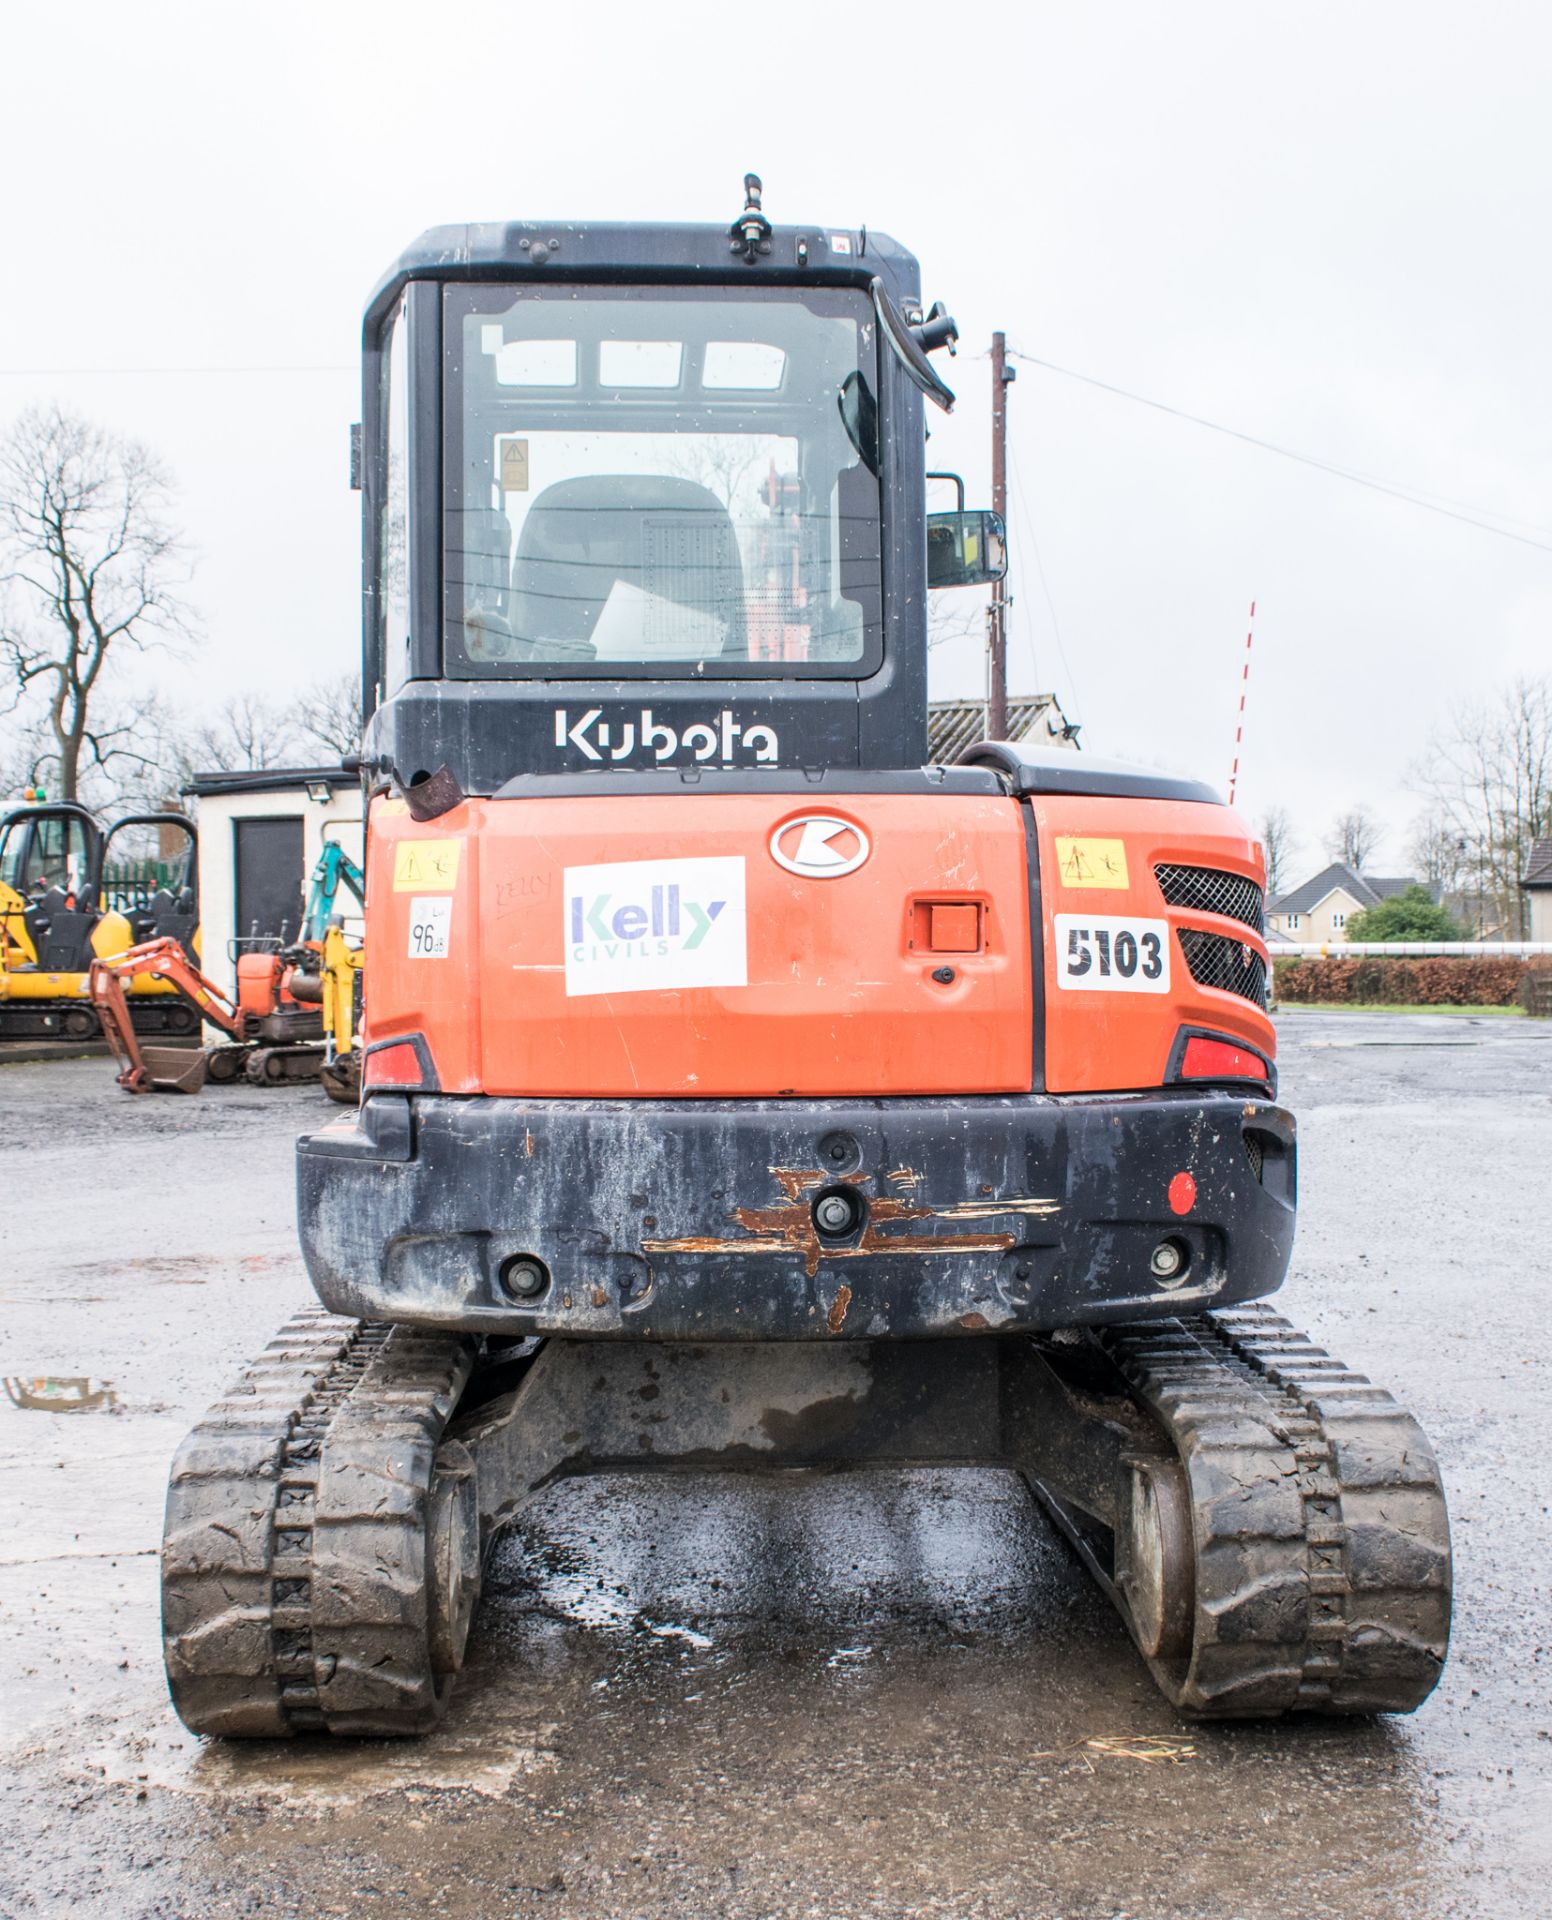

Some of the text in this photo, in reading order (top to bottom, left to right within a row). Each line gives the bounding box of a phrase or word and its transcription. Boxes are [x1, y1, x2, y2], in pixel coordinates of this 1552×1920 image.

[555, 709, 779, 761] Kubota
[412, 924, 435, 953] 96
[572, 884, 727, 950] Kelly
[573, 940, 670, 963] CIVILS
[1066, 929, 1163, 980] 5103
